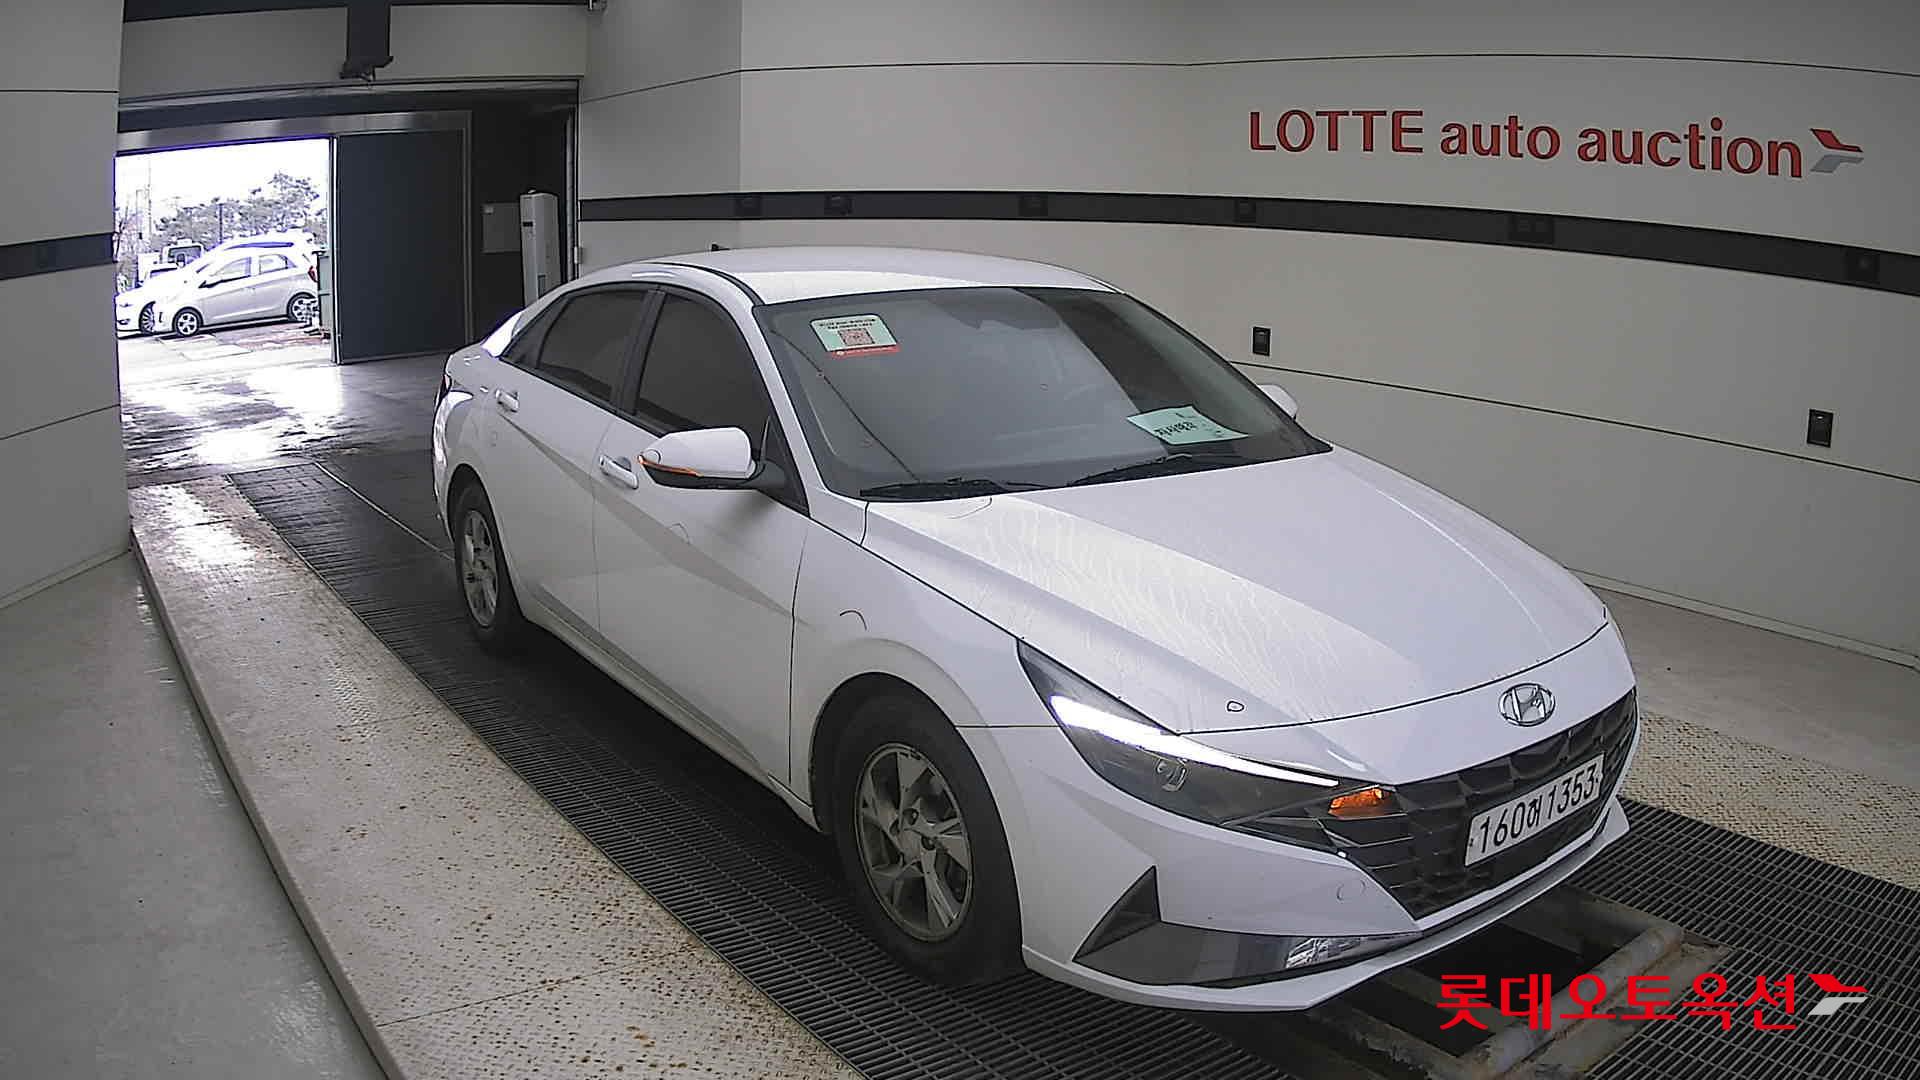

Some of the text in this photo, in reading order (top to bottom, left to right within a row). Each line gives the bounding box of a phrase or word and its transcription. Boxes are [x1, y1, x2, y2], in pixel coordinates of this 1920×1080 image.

[1250, 110, 1803, 178] LOTTE auto auction
